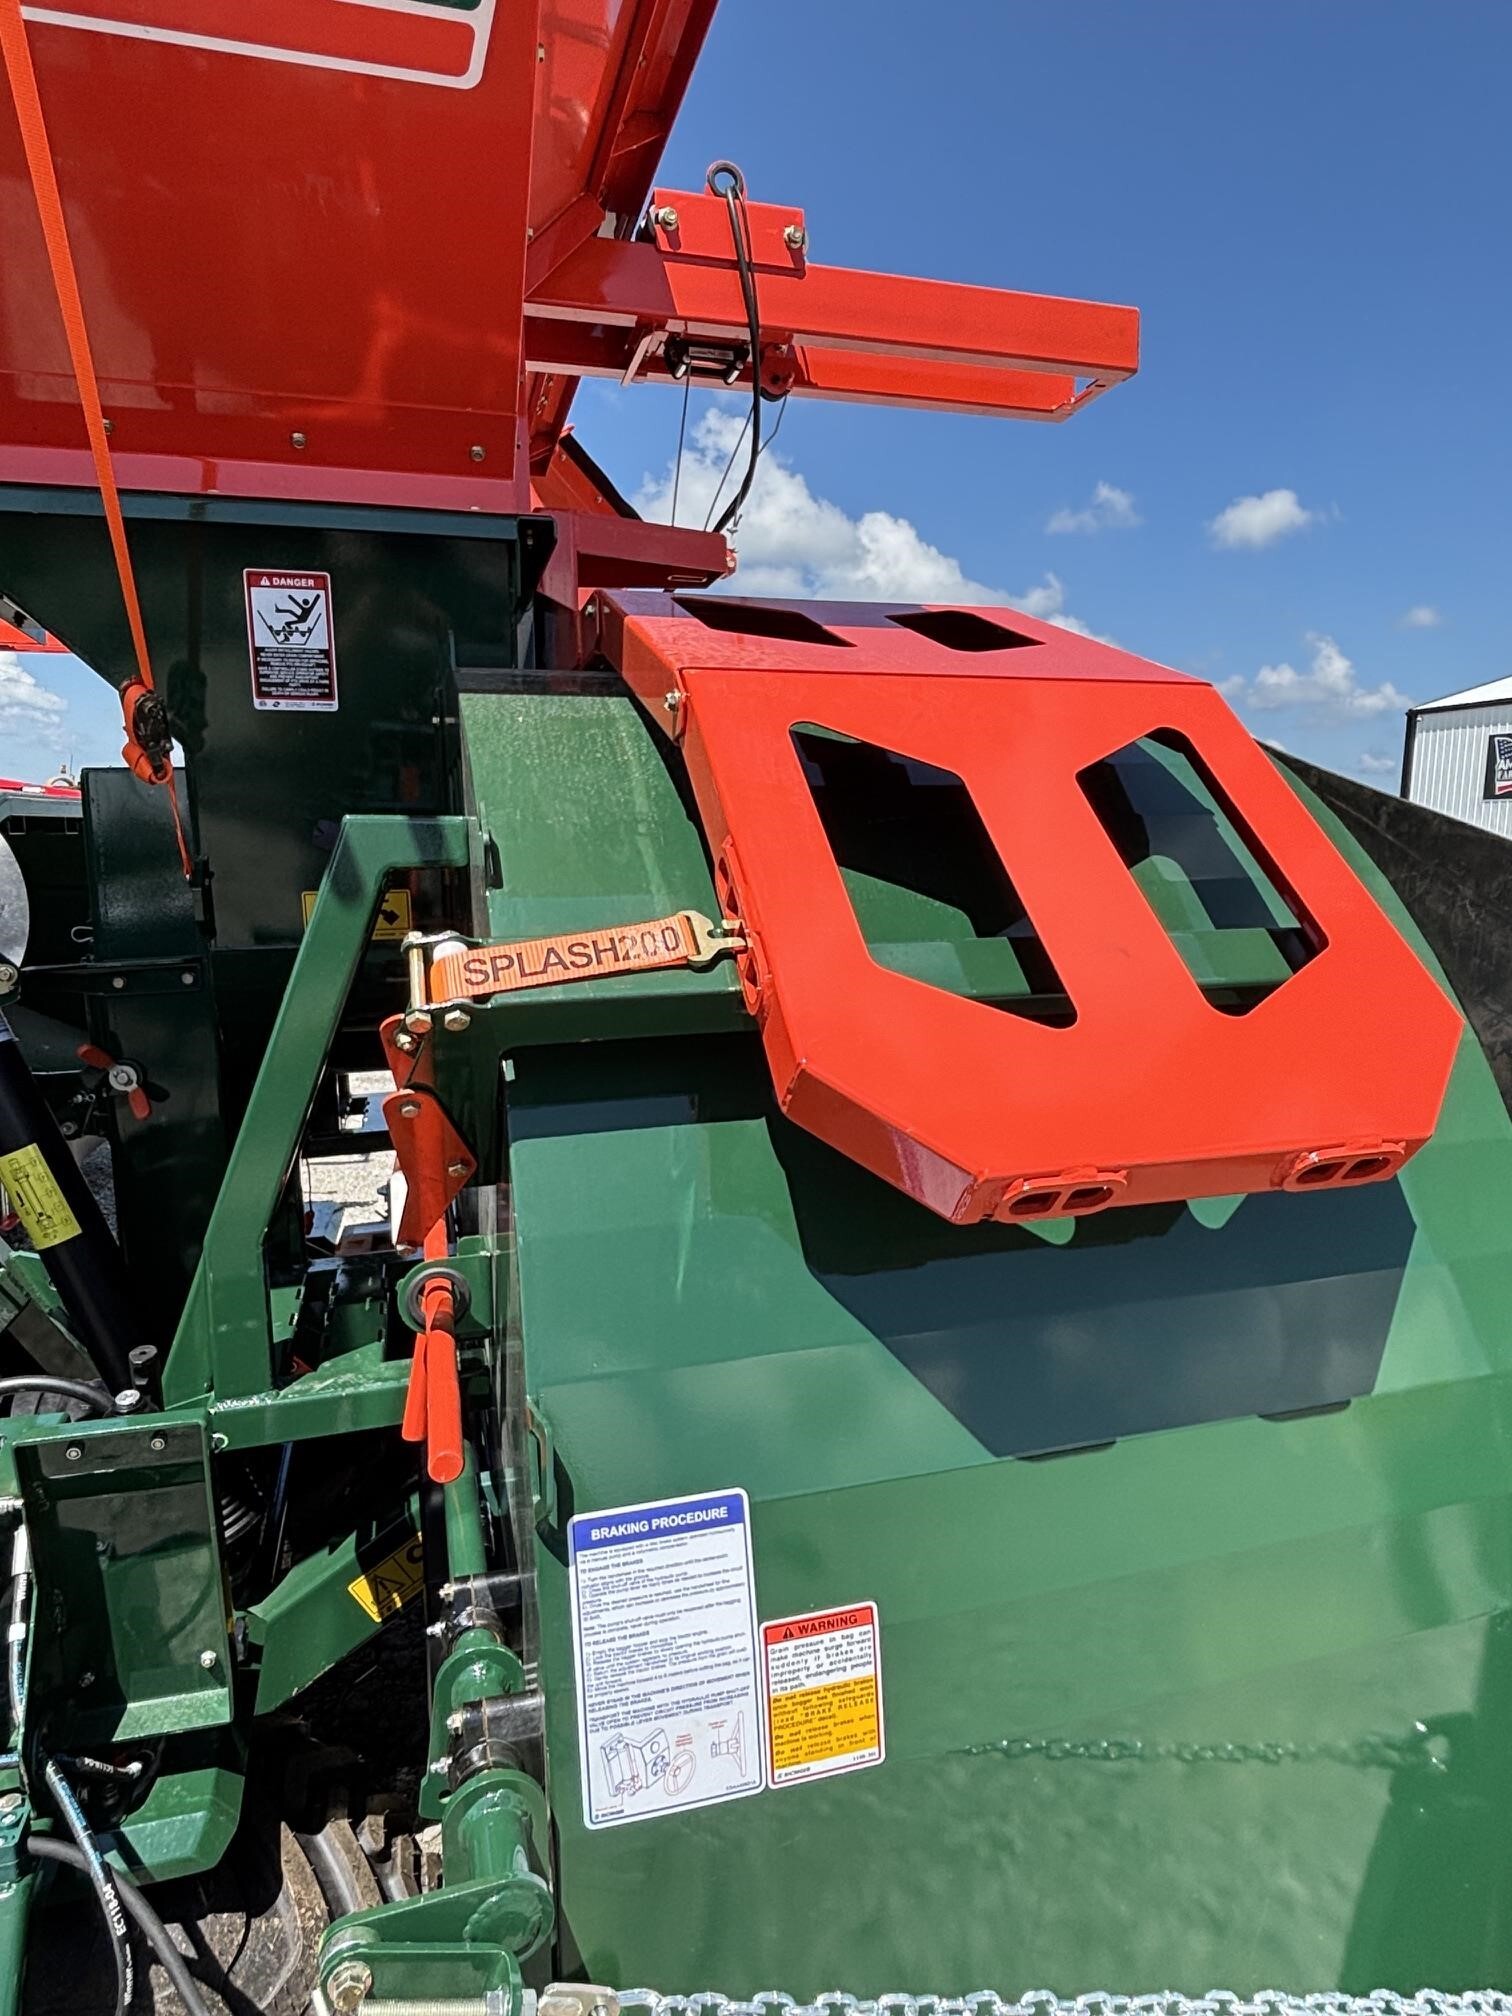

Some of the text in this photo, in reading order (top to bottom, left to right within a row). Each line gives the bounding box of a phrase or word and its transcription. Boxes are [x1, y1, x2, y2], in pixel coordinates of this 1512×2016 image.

[272, 577, 314, 587] DANGER
[464, 926, 680, 986] SPLASH200
[591, 1507, 727, 1540] BRAKING PROCEDURE
[798, 1614, 857, 1634] WARNING
[769, 1646, 789, 1654] Grain
[793, 1639, 823, 1650] pressure
[841, 1632, 854, 1640] bag
[823, 1643, 842, 1651] surge
[846, 1636, 871, 1646] forward
[770, 1658, 808, 1670] suddenly
[825, 1648, 853, 1659] brakes
[770, 1665, 810, 1677] improperly
[102, 1883, 127, 1936] EC118-04
